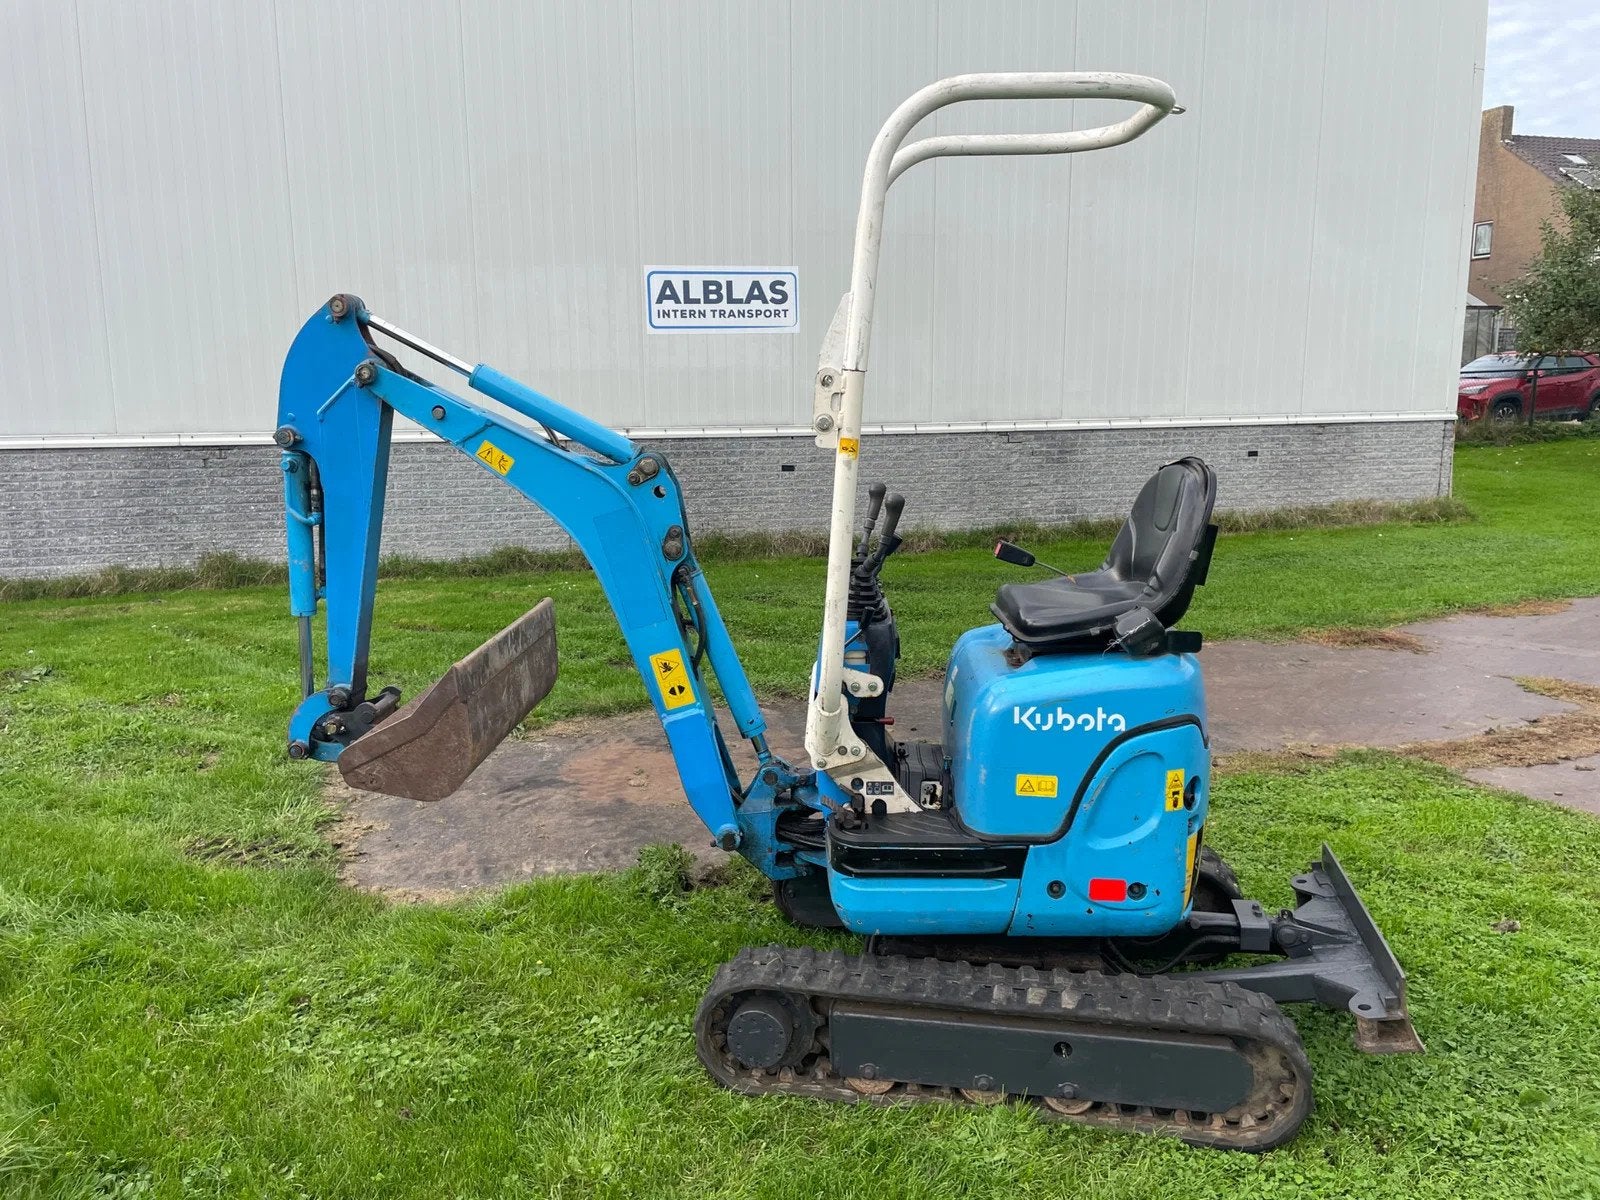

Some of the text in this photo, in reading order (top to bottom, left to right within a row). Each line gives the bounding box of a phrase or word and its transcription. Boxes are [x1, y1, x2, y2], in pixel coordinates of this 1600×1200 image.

[655, 280, 789, 305] ALBLAS
[657, 308, 789, 319] INTERN TRANSPORT
[1013, 706, 1126, 732] Kubota
